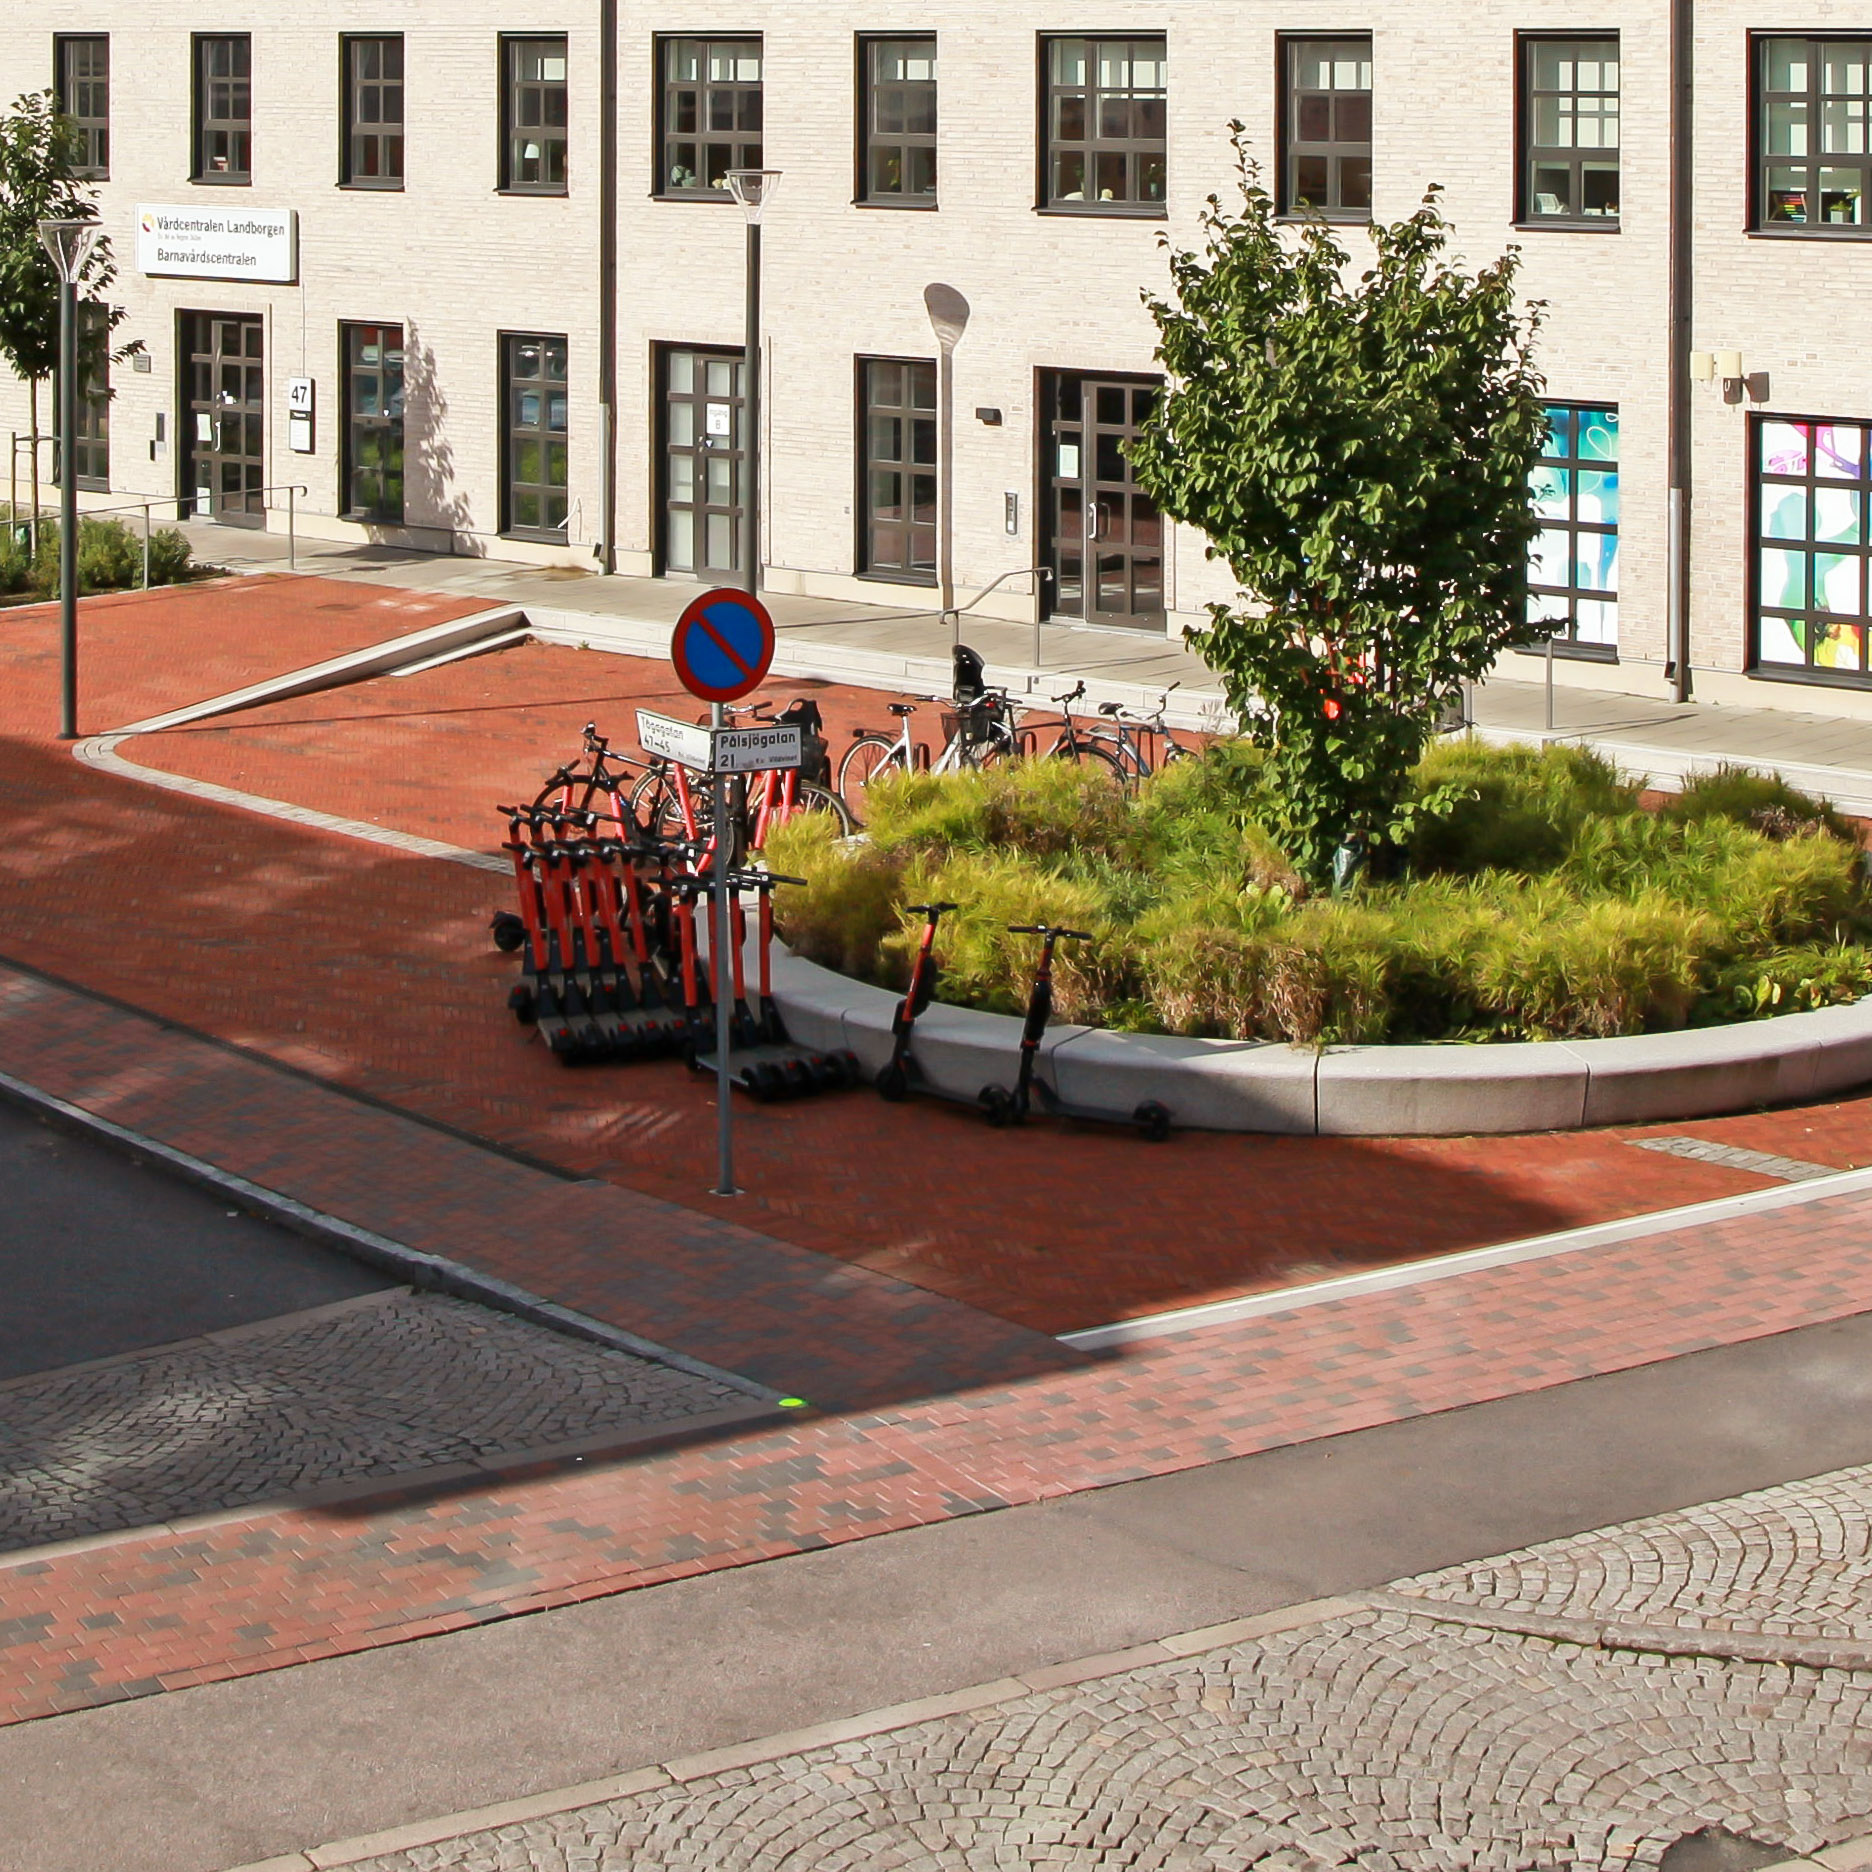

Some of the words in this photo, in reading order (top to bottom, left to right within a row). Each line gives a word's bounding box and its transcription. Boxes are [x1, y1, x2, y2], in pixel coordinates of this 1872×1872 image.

[157, 216, 224, 233] Vårdcentralen
[227, 220, 285, 238] Landborgen
[157, 248, 257, 266] Barnavårdscentralen
[291, 385, 308, 404] 47
[720, 732, 796, 750] Pålsjögatan
[720, 754, 735, 768] 21
